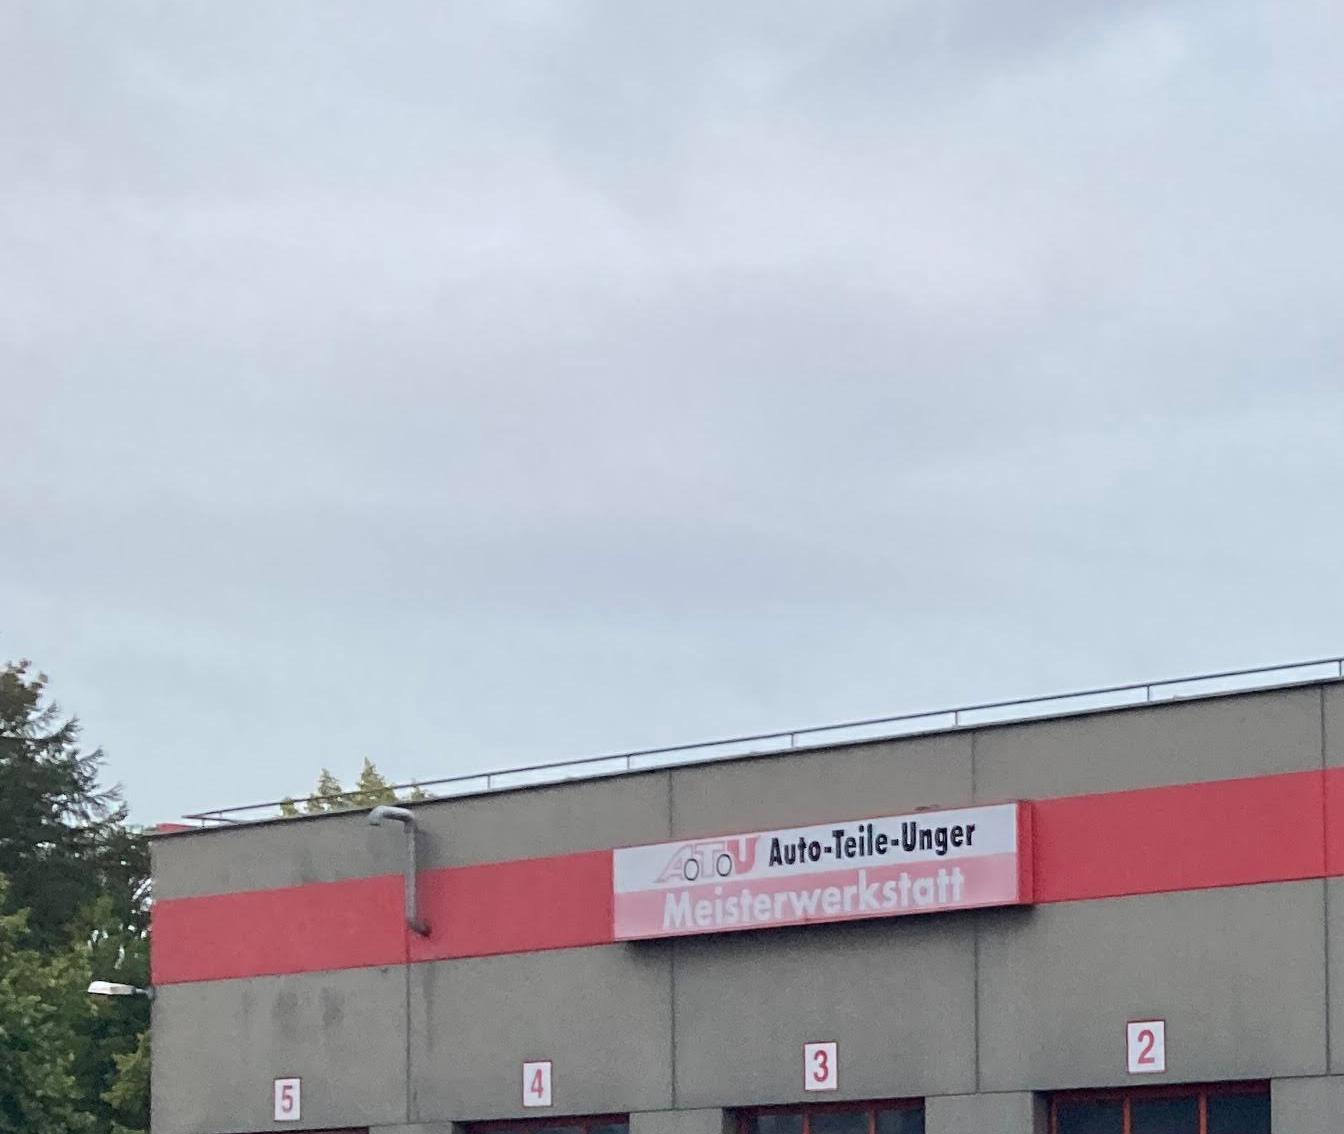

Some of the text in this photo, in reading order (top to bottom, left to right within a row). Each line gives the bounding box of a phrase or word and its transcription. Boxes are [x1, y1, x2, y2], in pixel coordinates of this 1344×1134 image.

[769, 821, 977, 867] Auto-Teile-Unger
[662, 867, 965, 930] Meisterwerkstatt
[1137, 1029, 1155, 1064] 2
[813, 1049, 829, 1082] 3
[281, 1085, 293, 1113] 5
[530, 1068, 544, 1099] 4
